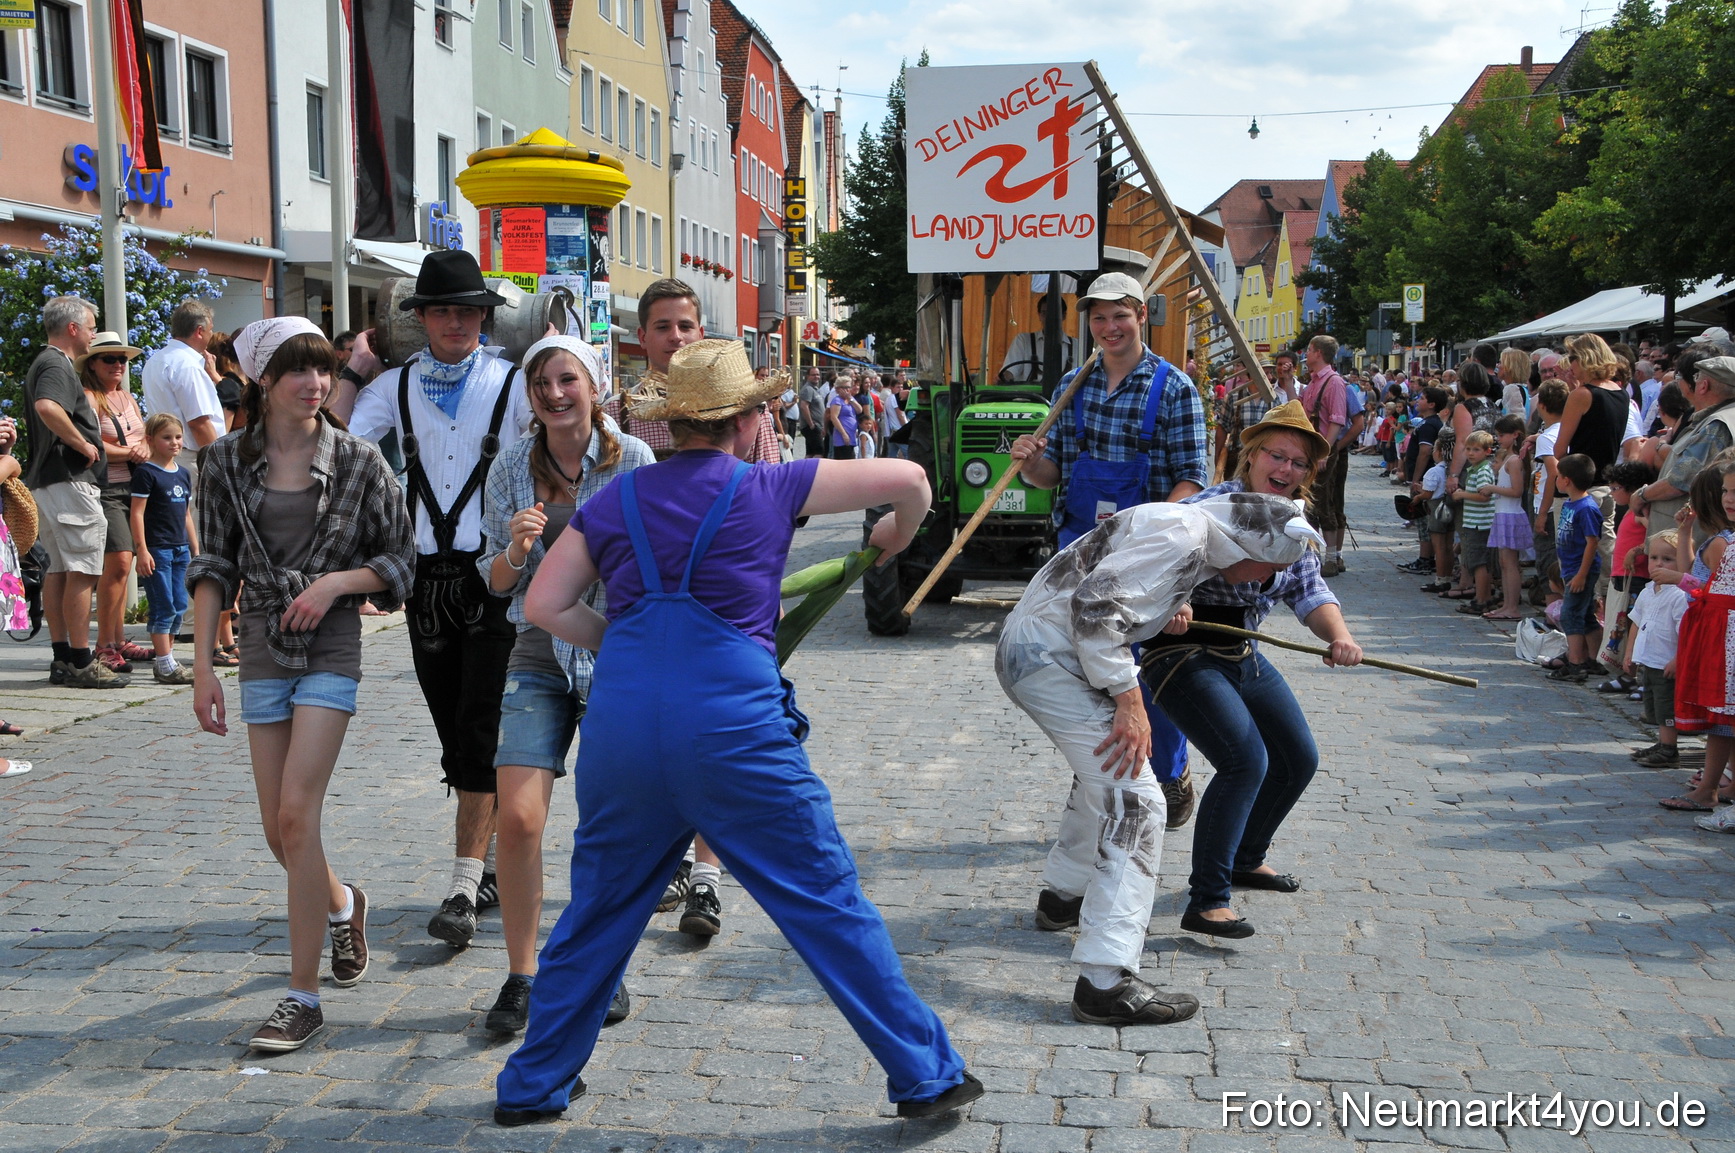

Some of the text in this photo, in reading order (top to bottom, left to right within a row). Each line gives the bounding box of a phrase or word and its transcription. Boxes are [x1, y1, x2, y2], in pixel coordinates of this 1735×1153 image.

[914, 67, 1073, 162] DEININGER
[786, 180, 806, 290] HOTEL
[911, 213, 1095, 260] LANDJUGEND
[512, 275, 534, 286] Club
[974, 412, 1033, 420] DEUTZ
[1005, 501, 1023, 510] 381
